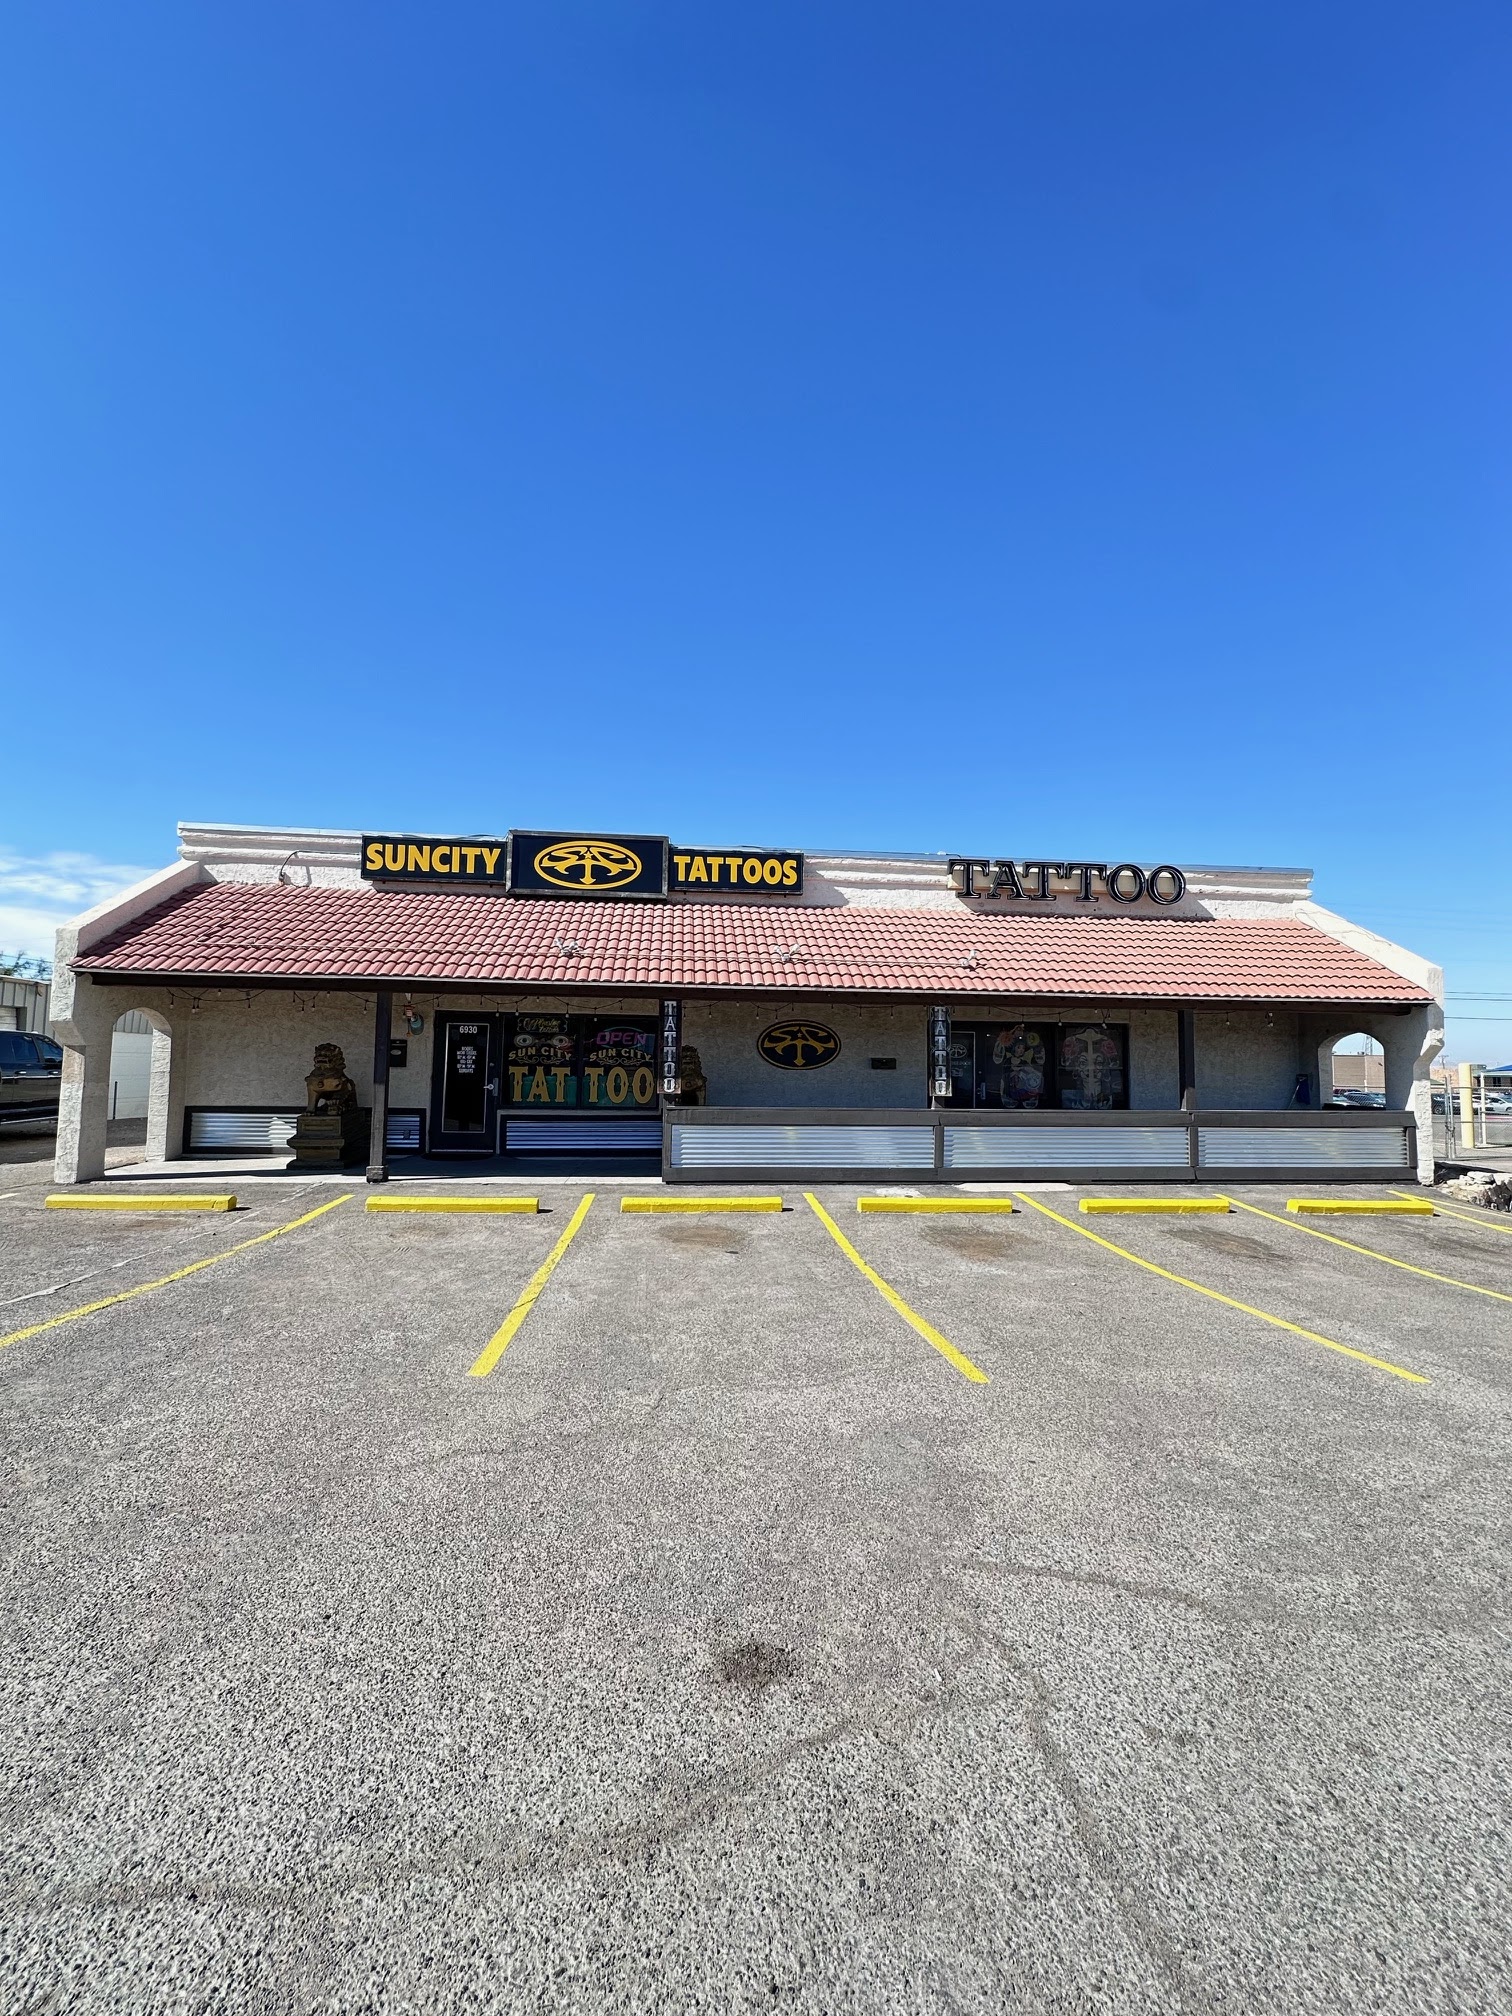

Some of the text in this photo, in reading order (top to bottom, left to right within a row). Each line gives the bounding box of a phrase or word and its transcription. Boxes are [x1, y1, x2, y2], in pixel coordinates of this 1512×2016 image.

[366, 842, 501, 875] SUNCITY
[674, 854, 798, 886] TATTOOS
[948, 858, 1187, 905] TATTOO
[459, 1025, 478, 1034] 6930
[596, 1031, 647, 1045] OPEN
[508, 1046, 572, 1061] SUN CITY
[589, 1047, 652, 1062] SUN CITY
[664, 1001, 677, 1092] TATTOO
[934, 1006, 947, 1095] TATTOO
